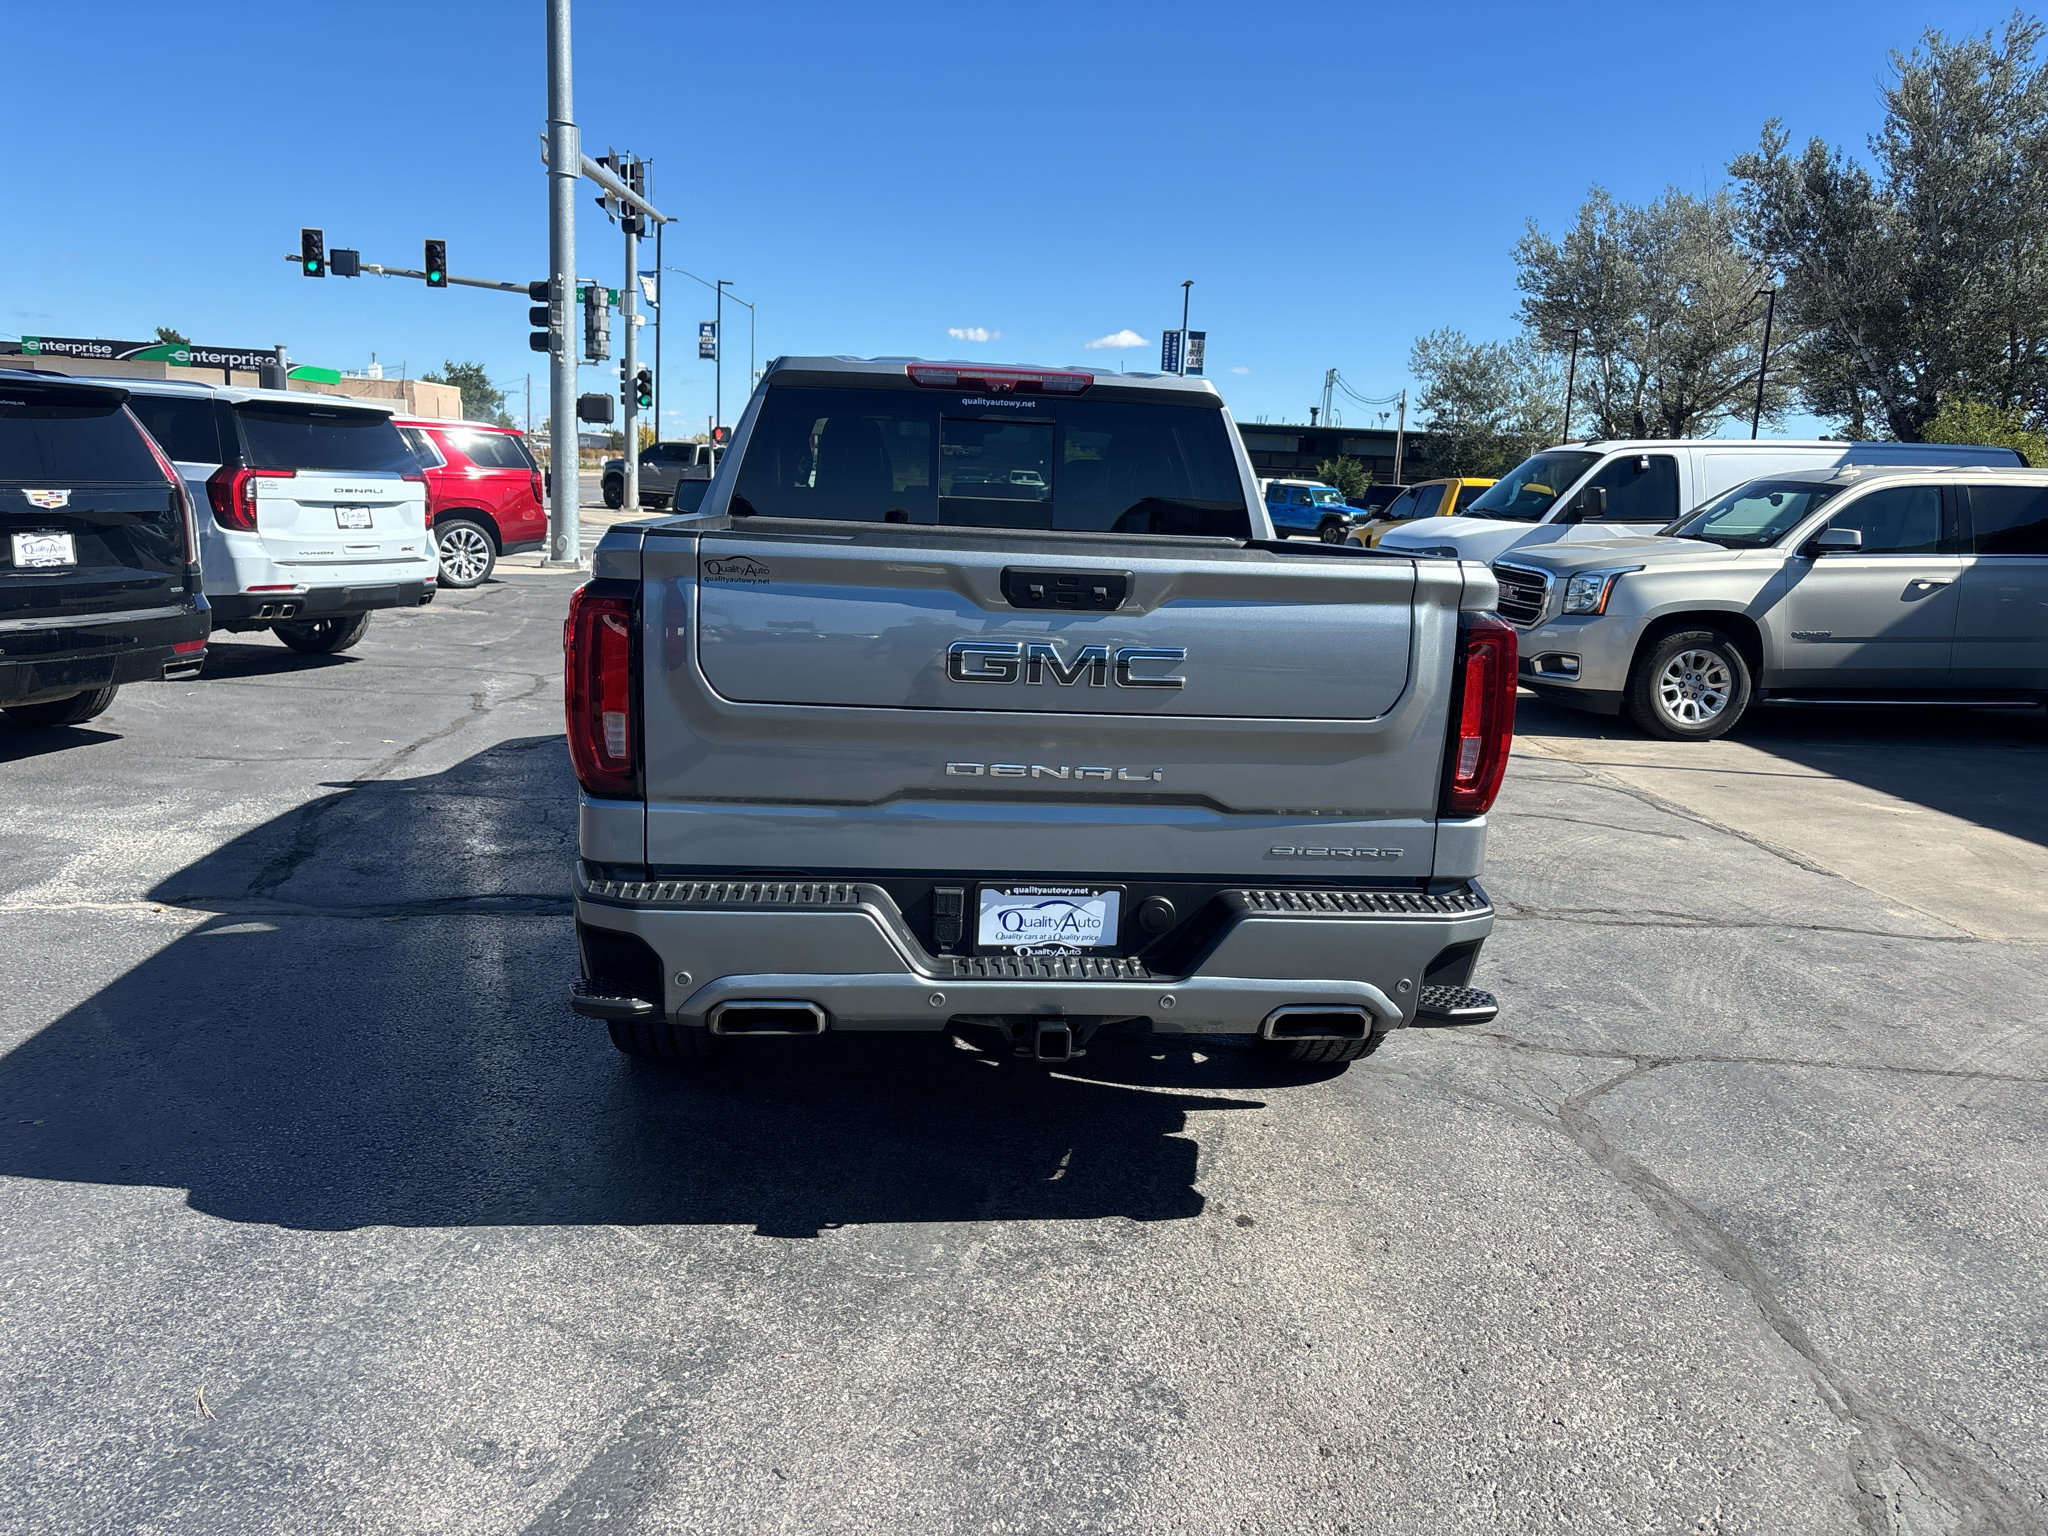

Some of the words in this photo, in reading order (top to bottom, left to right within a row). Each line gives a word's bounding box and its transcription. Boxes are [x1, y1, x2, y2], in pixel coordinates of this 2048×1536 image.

[22, 340, 112, 355] enterprise
[1191, 340, 1203, 348] WE
[1170, 333, 1178, 371] FINANCING
[1188, 349, 1203, 357] BUY
[168, 350, 277, 367] enterprise
[1187, 357, 1203, 366] CARS
[962, 397, 1036, 409] qualityautowy.net
[704, 575, 770, 585] qualityautowy.net
[946, 640, 1188, 690] GMC
[946, 761, 1163, 782] DENALI
[1271, 846, 1405, 858] SIERRA
[1013, 886, 1089, 896] qualityautowy.net
[995, 931, 1022, 941] Quality
[1053, 931, 1080, 942] Quality
[1081, 934, 1099, 942] price
